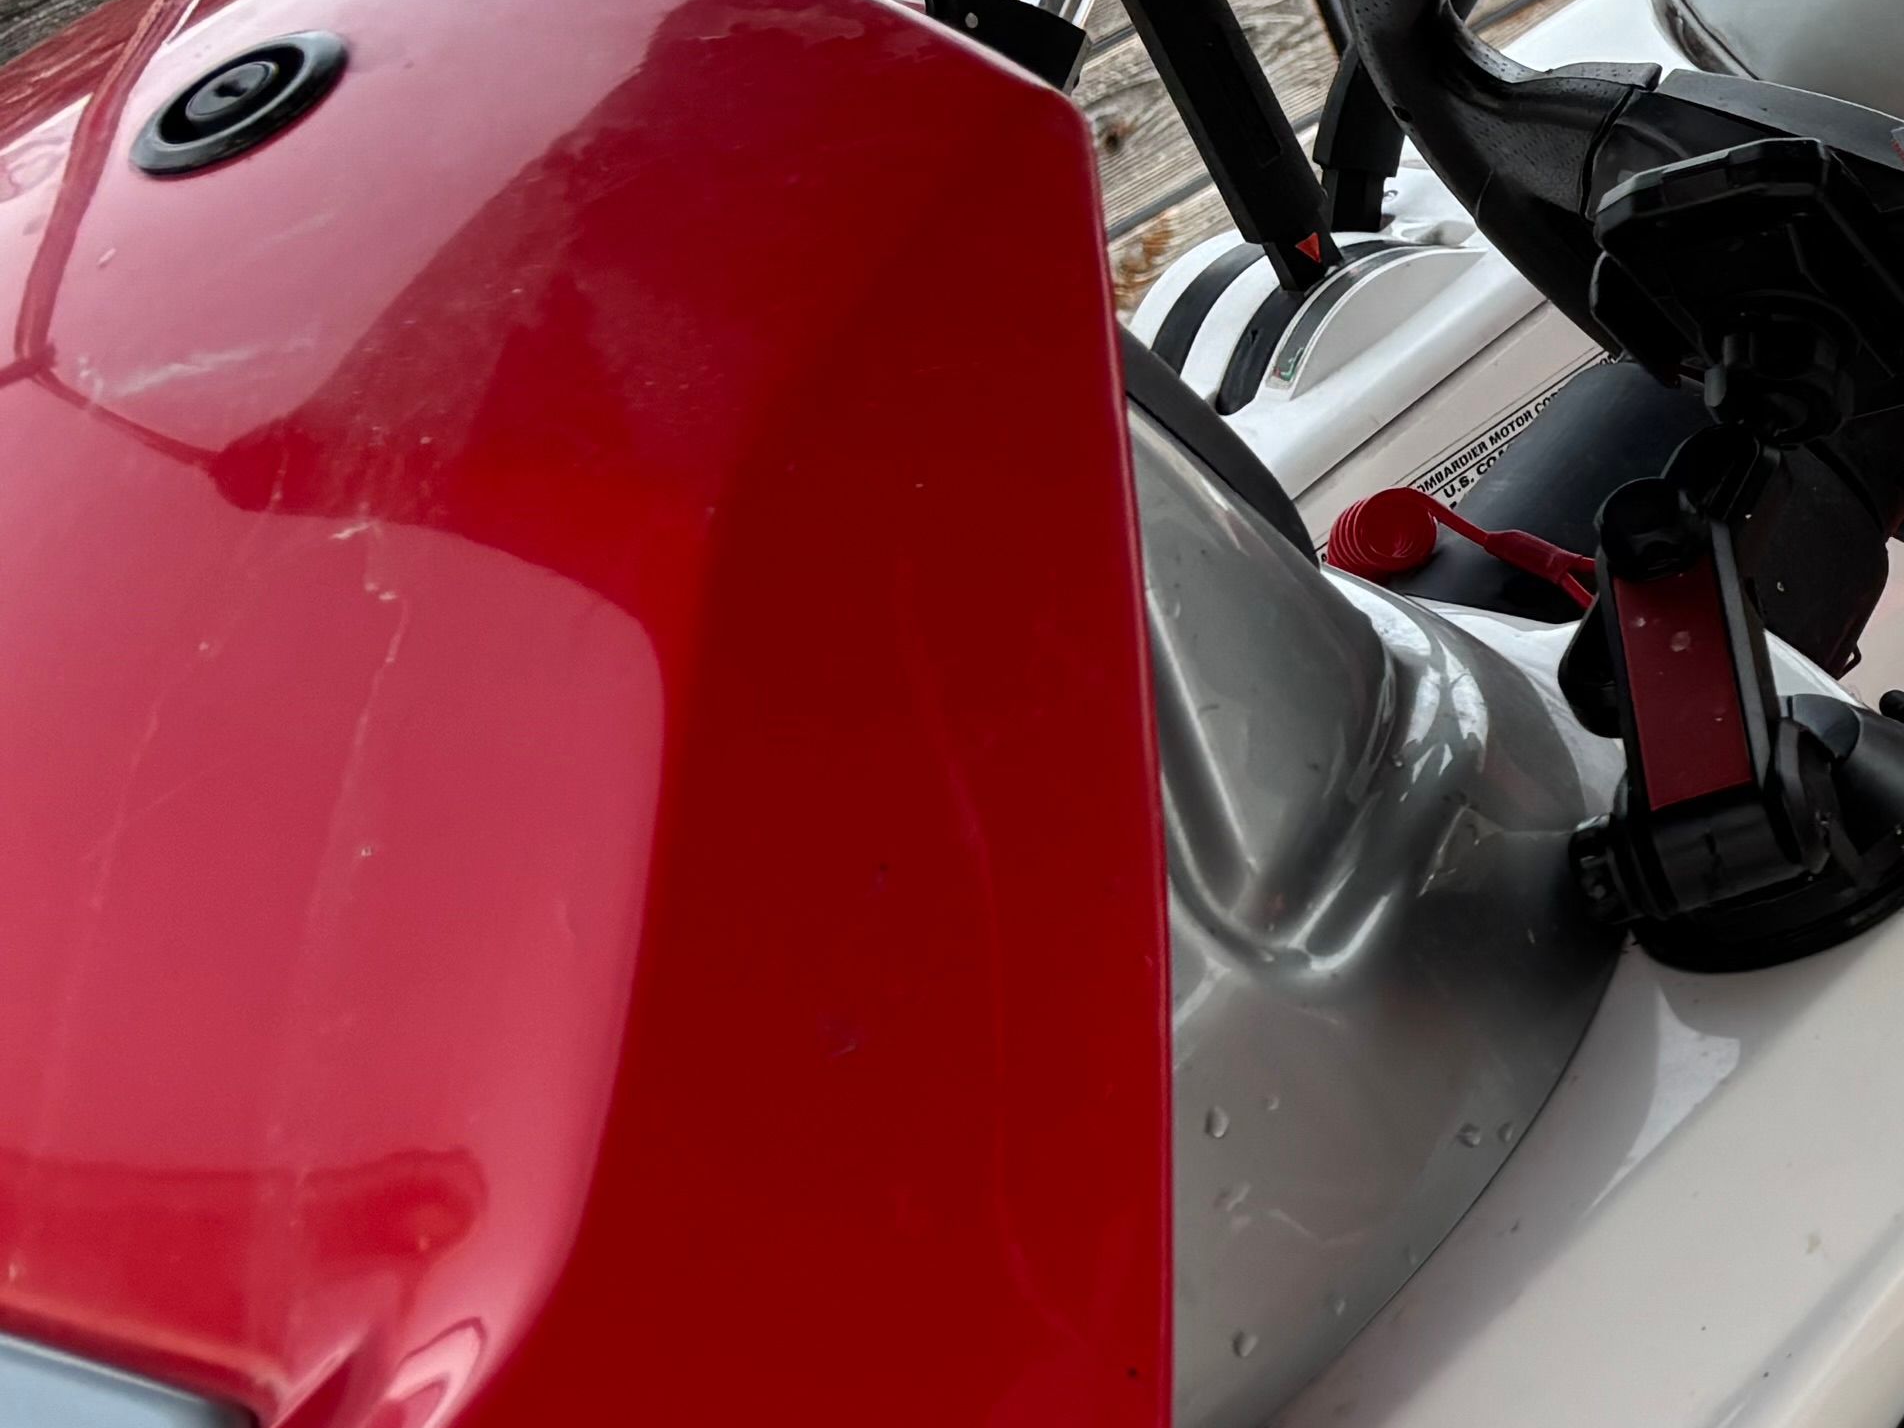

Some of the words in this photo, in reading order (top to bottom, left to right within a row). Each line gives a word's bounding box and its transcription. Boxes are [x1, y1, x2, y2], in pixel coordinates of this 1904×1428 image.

[1417, 441, 1488, 493] OMBARDIER
[1489, 410, 1534, 446] MOTOR
[1443, 475, 1475, 498] U.S.
